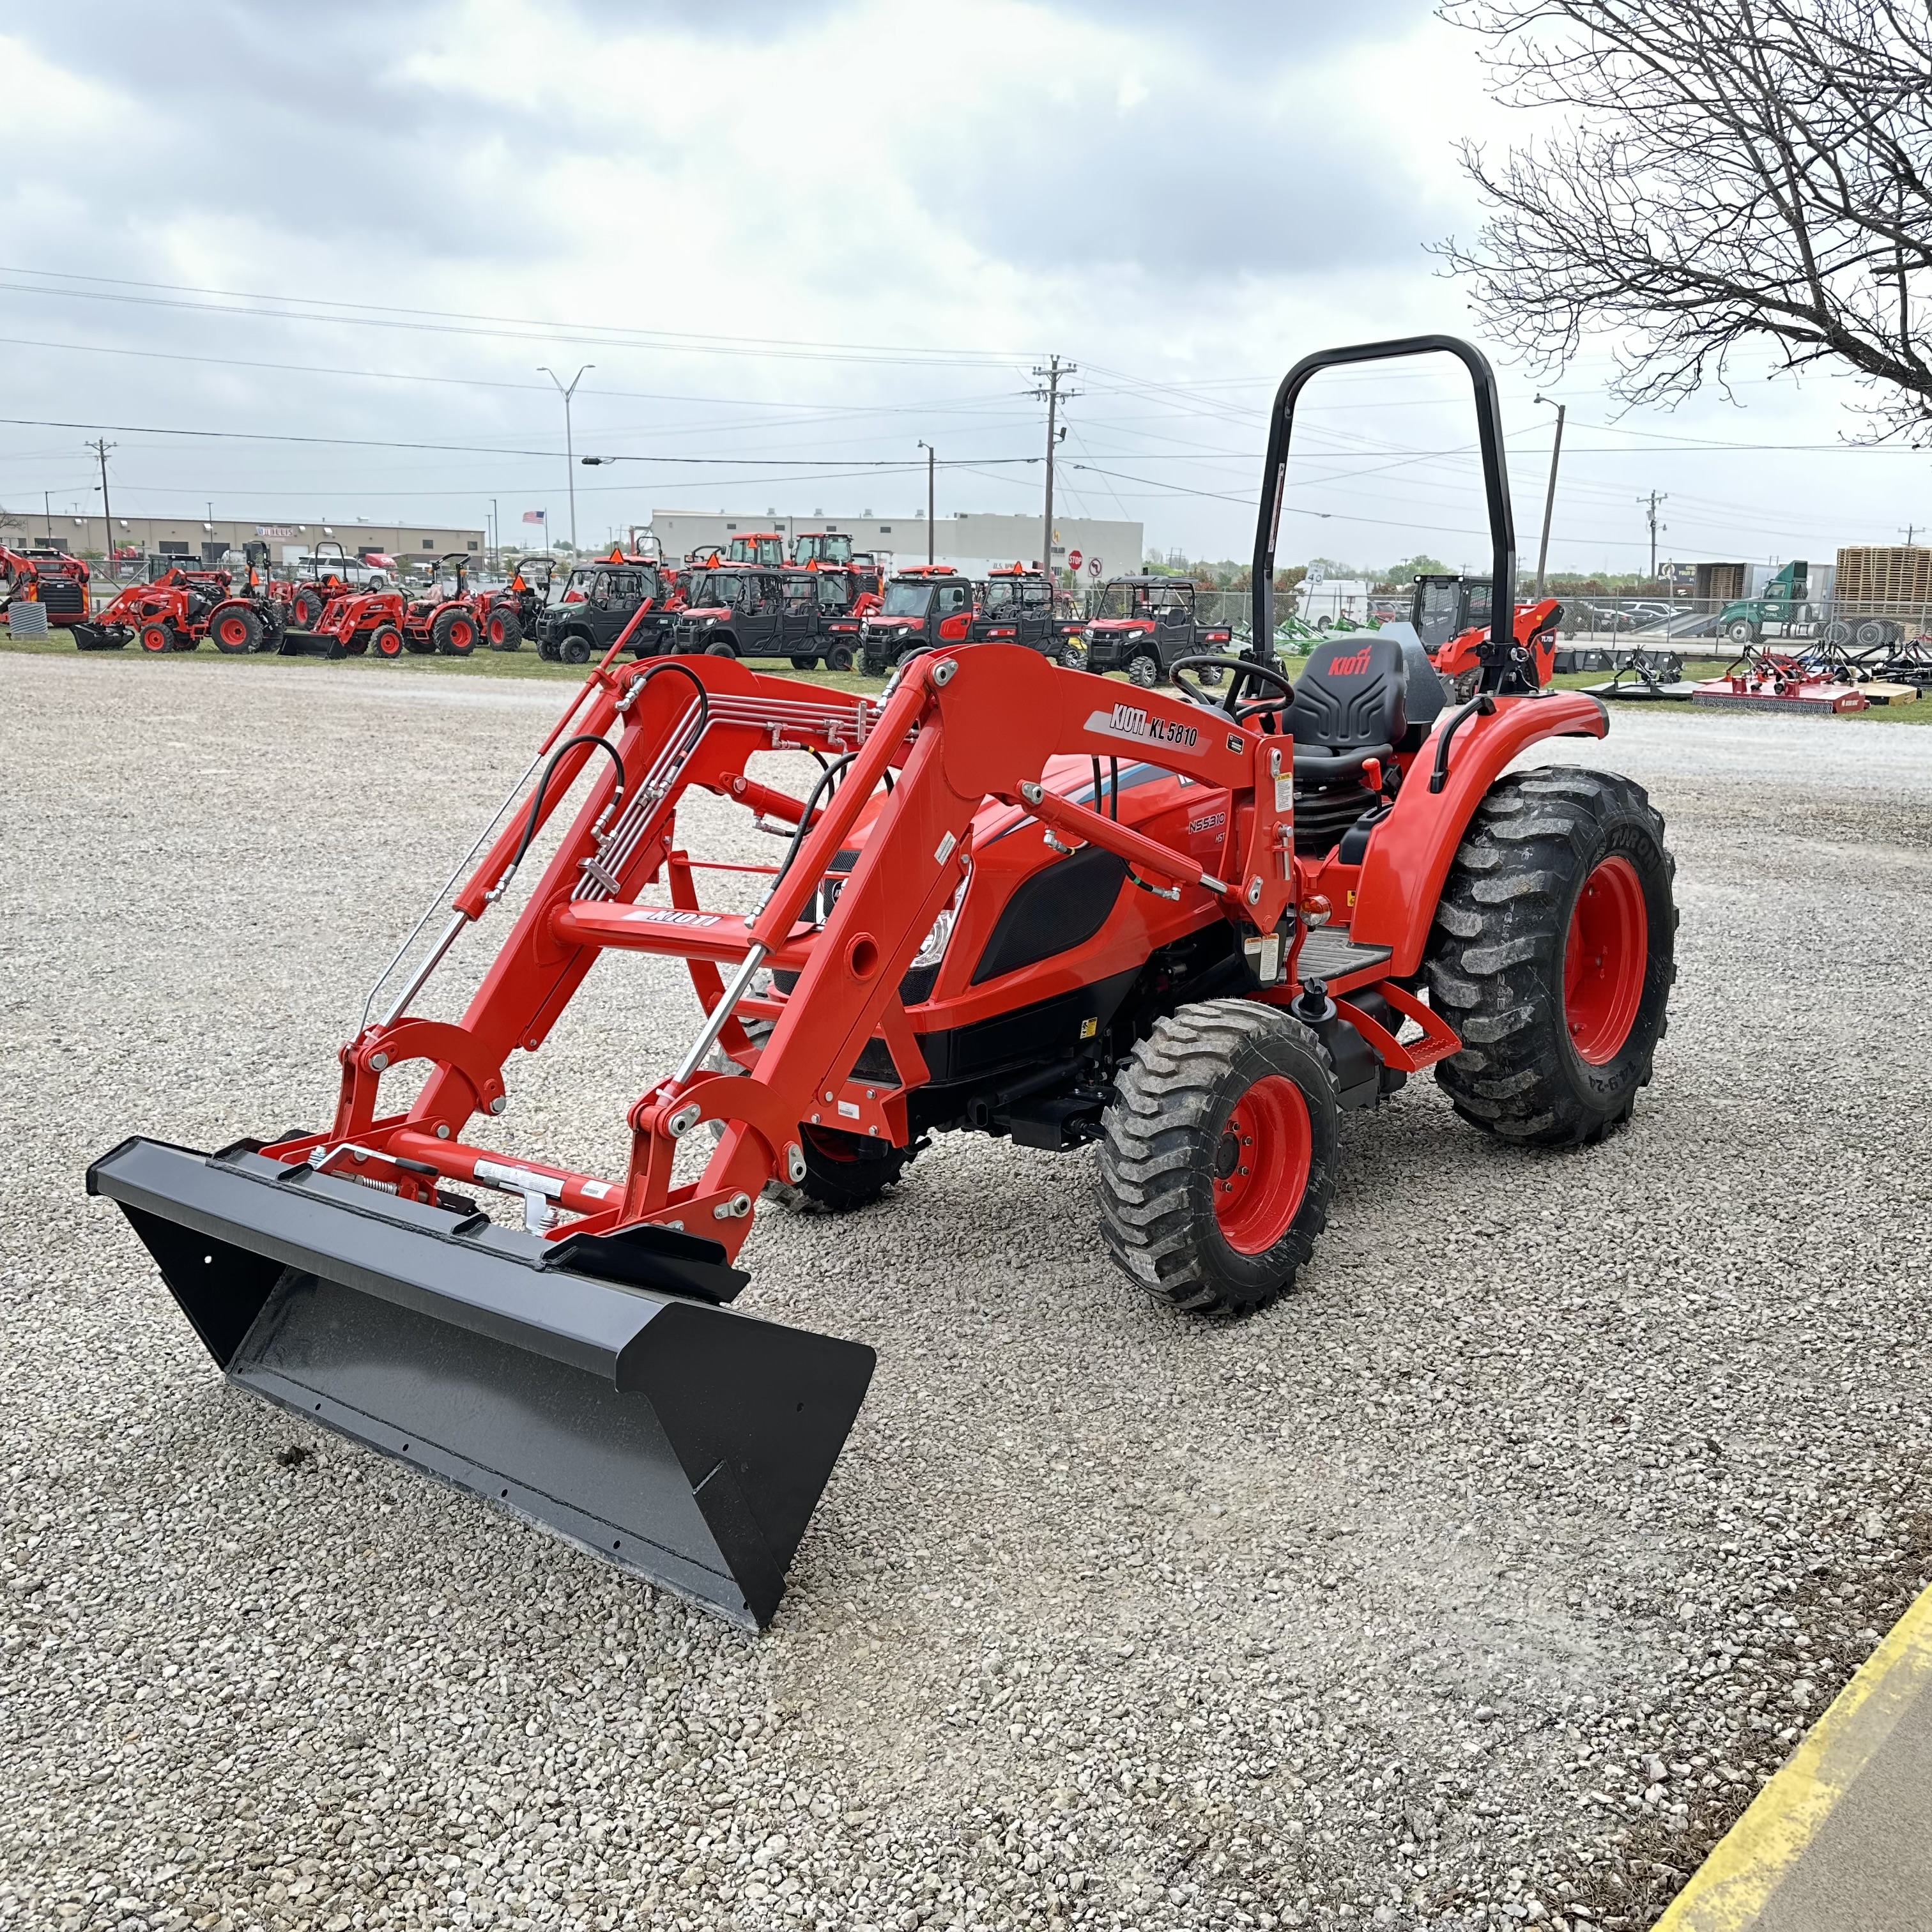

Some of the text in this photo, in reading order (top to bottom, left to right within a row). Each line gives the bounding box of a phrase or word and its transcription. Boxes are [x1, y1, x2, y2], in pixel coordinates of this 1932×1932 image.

[1069, 555, 1082, 564] STOP
[1308, 574, 1322, 582] 40
[1328, 653, 1371, 675] KIOTI
[1110, 703, 1147, 735] KIOTI
[1149, 717, 1165, 740] KL
[1167, 722, 1198, 747] 5810
[1189, 812, 1225, 834] NS5310
[1215, 832, 1225, 843] HST
[647, 910, 724, 927] KIOTI
